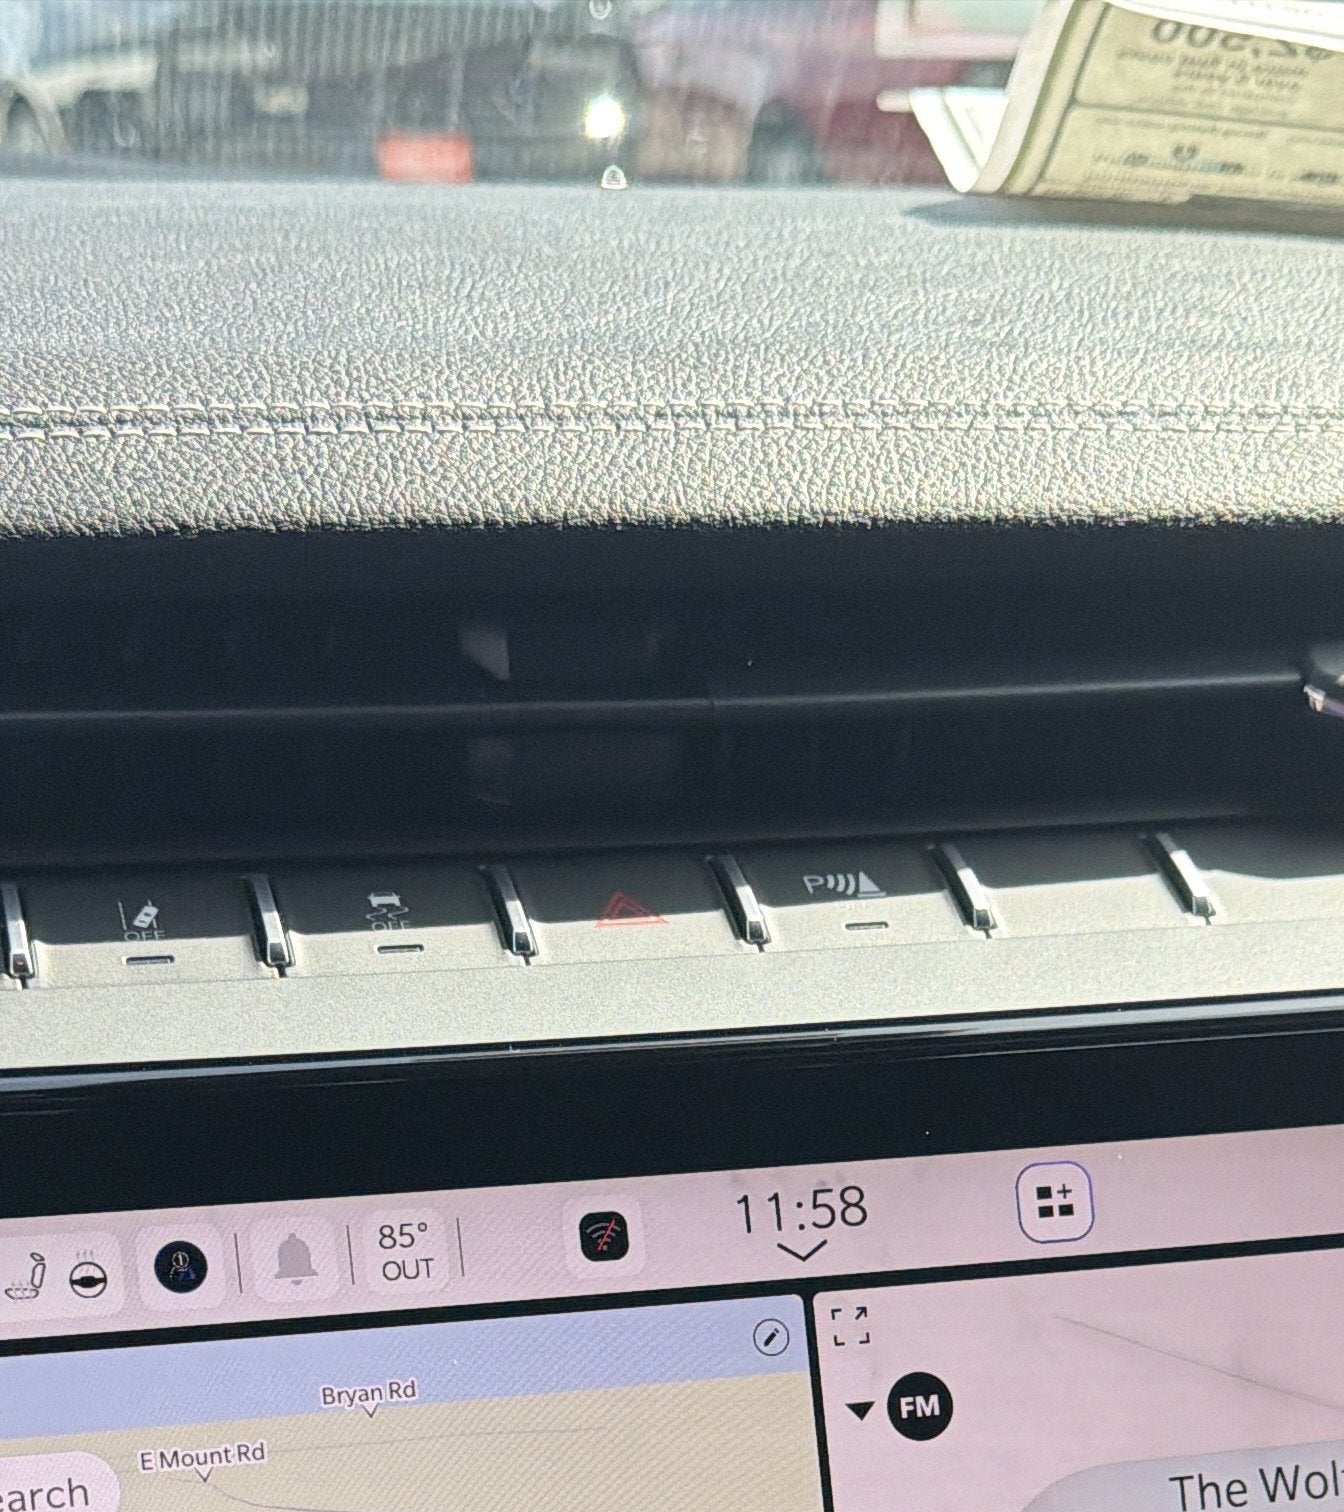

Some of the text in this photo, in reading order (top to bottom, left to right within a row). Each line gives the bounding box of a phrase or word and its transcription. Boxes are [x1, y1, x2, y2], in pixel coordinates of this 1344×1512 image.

[123, 929, 166, 942] OFF
[371, 919, 411, 933] OFF
[736, 1186, 868, 1236] 11:58
[377, 1221, 429, 1251] 85°
[381, 1257, 435, 1282] OUT
[322, 1380, 417, 1409] Bryan Rd
[899, 1394, 941, 1419] FM
[140, 1441, 266, 1471] E Mount Rd
